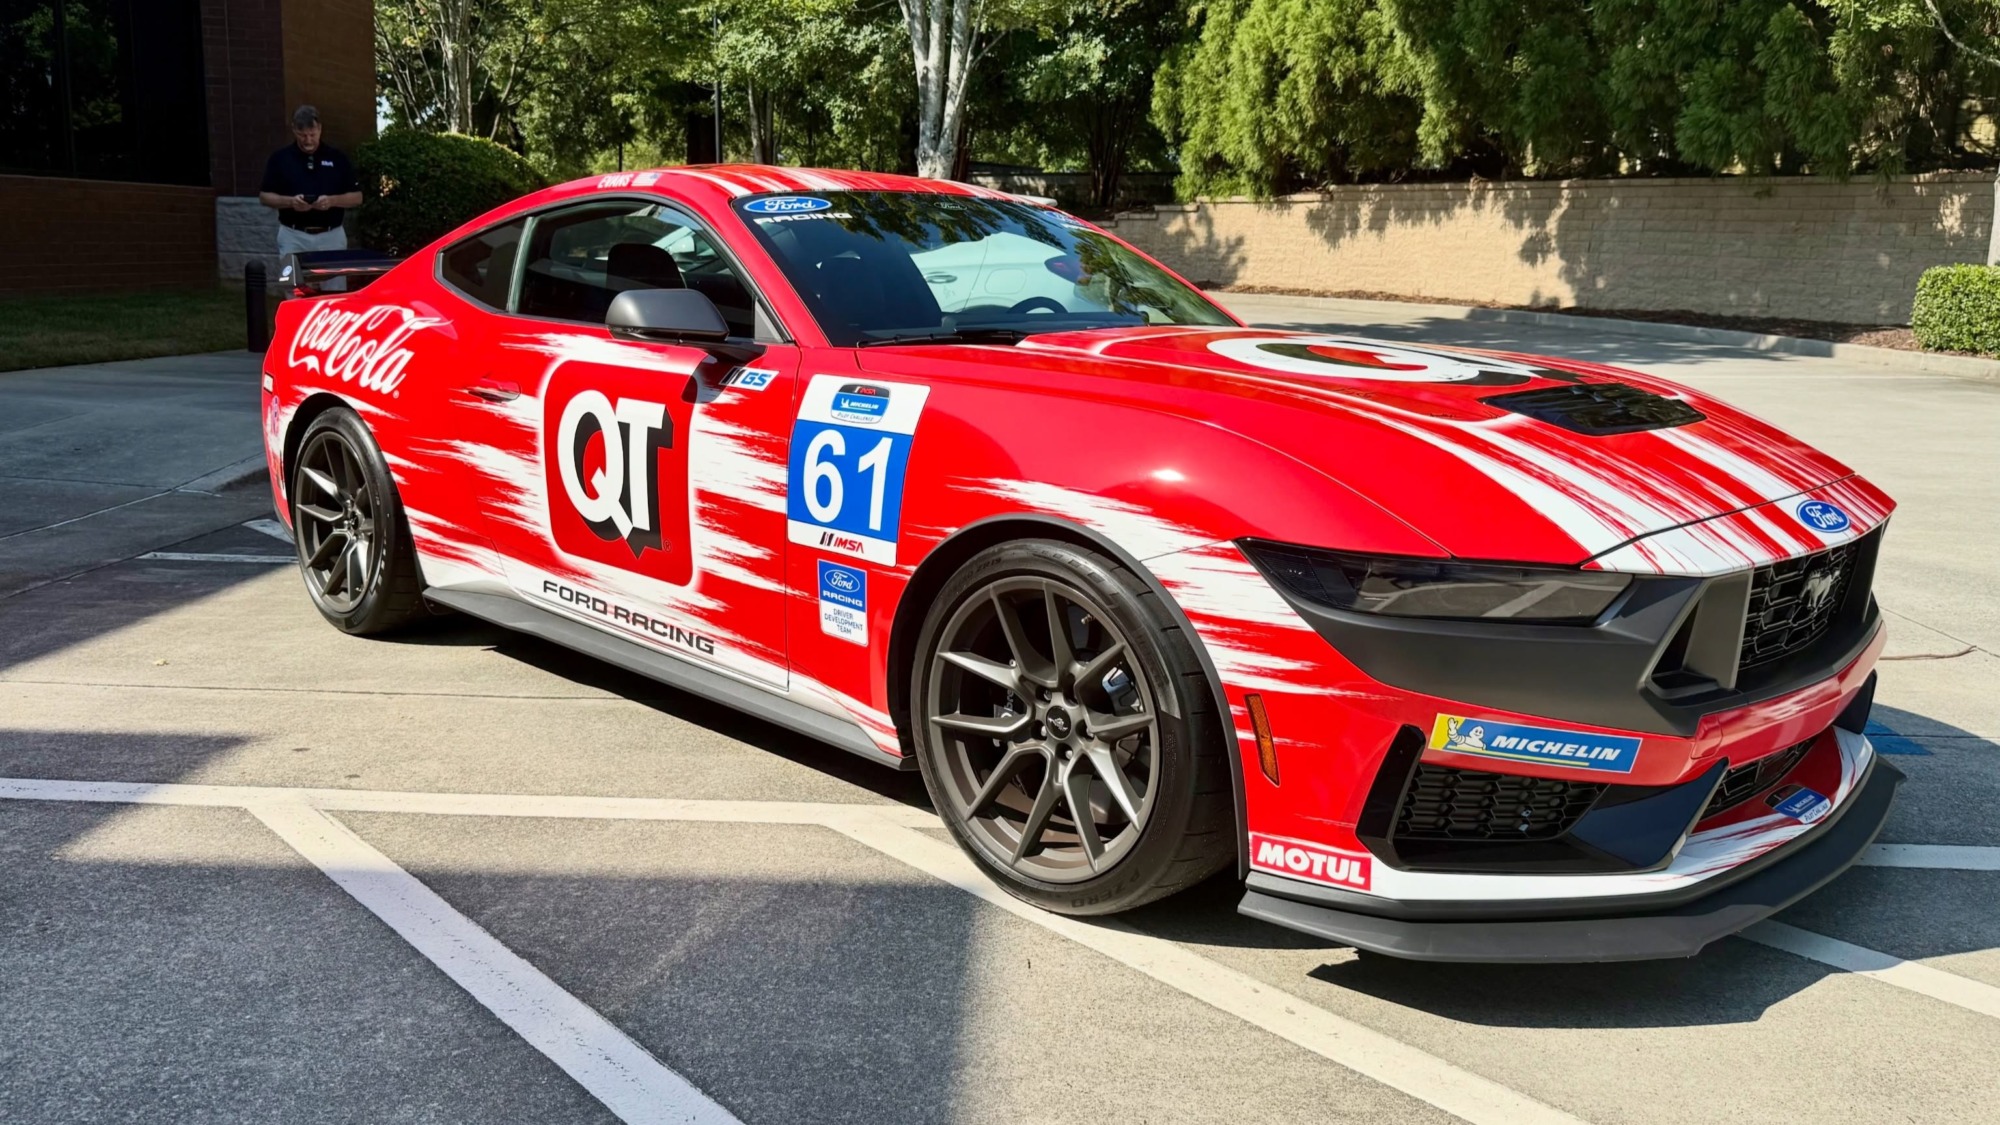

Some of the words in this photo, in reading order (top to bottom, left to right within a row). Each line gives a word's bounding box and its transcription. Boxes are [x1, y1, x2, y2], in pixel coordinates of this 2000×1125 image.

[597, 172, 634, 189] EVANS
[753, 212, 853, 225] RACING
[288, 298, 453, 394] Coca-Cola
[740, 371, 772, 387] GS
[557, 389, 666, 541] QT
[803, 429, 893, 531] 61
[834, 537, 864, 553] IMSA
[822, 590, 863, 607] RACING
[543, 580, 608, 616] FORD
[613, 605, 714, 655] RACING
[824, 613, 863, 631] DEVELOPMENT
[833, 608, 853, 619] DRIVER
[837, 624, 852, 635] TEAM
[1491, 736, 1621, 761] MICHELIN
[1257, 841, 1365, 885] MOTUL
